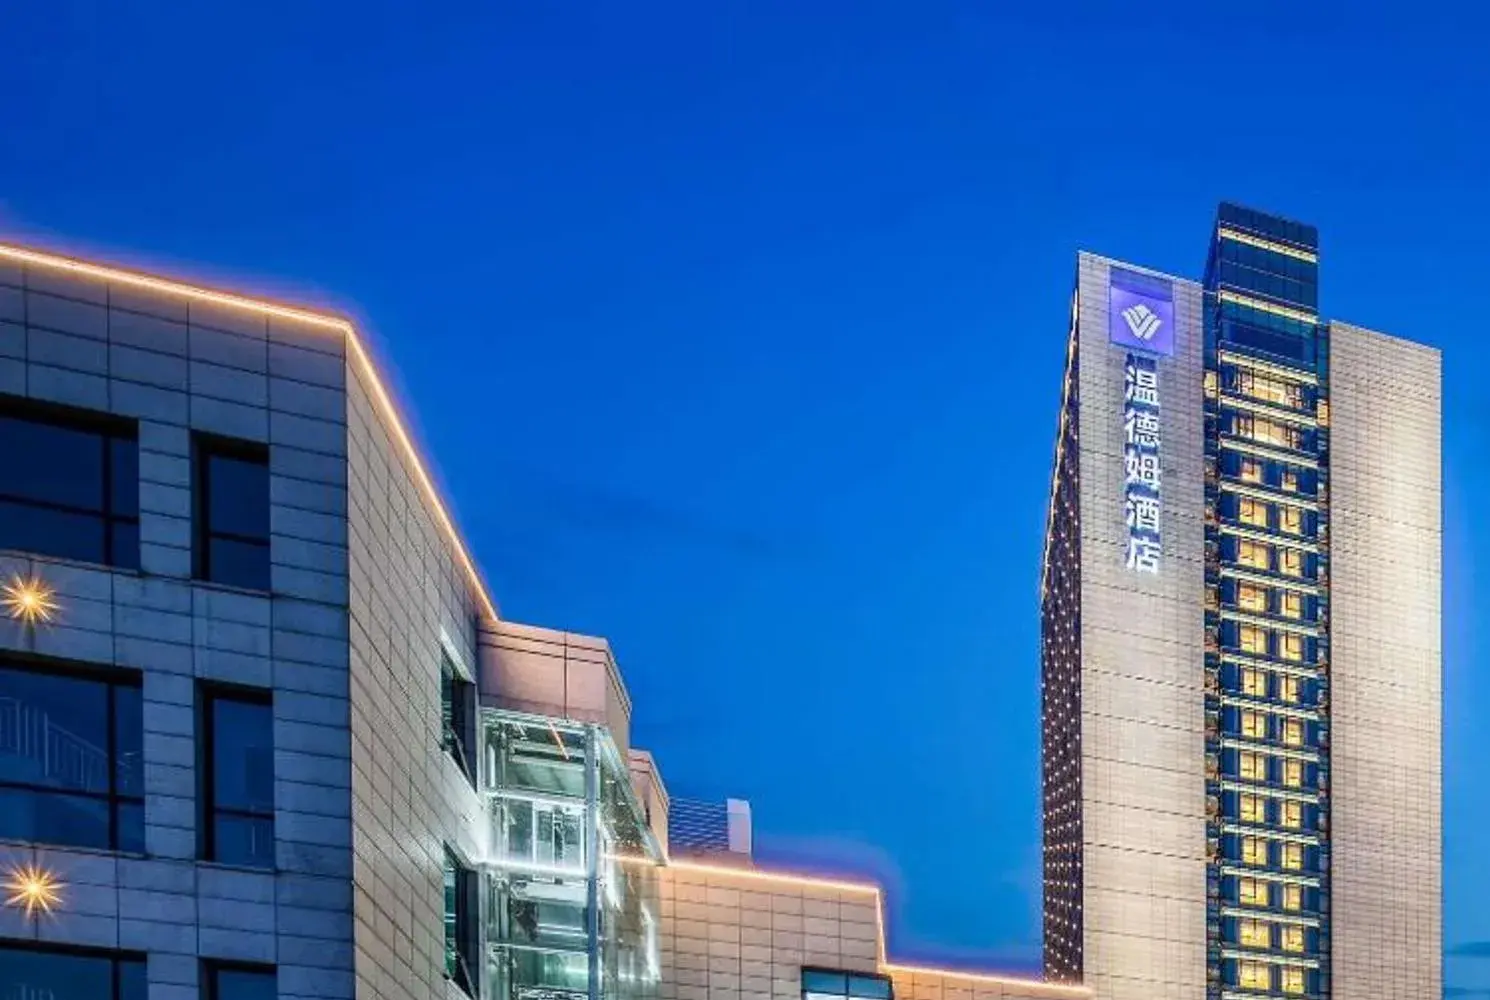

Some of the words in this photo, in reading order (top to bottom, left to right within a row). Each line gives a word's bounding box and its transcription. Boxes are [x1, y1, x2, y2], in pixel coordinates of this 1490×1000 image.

[1125, 365, 1161, 574] 温德姆酒店
